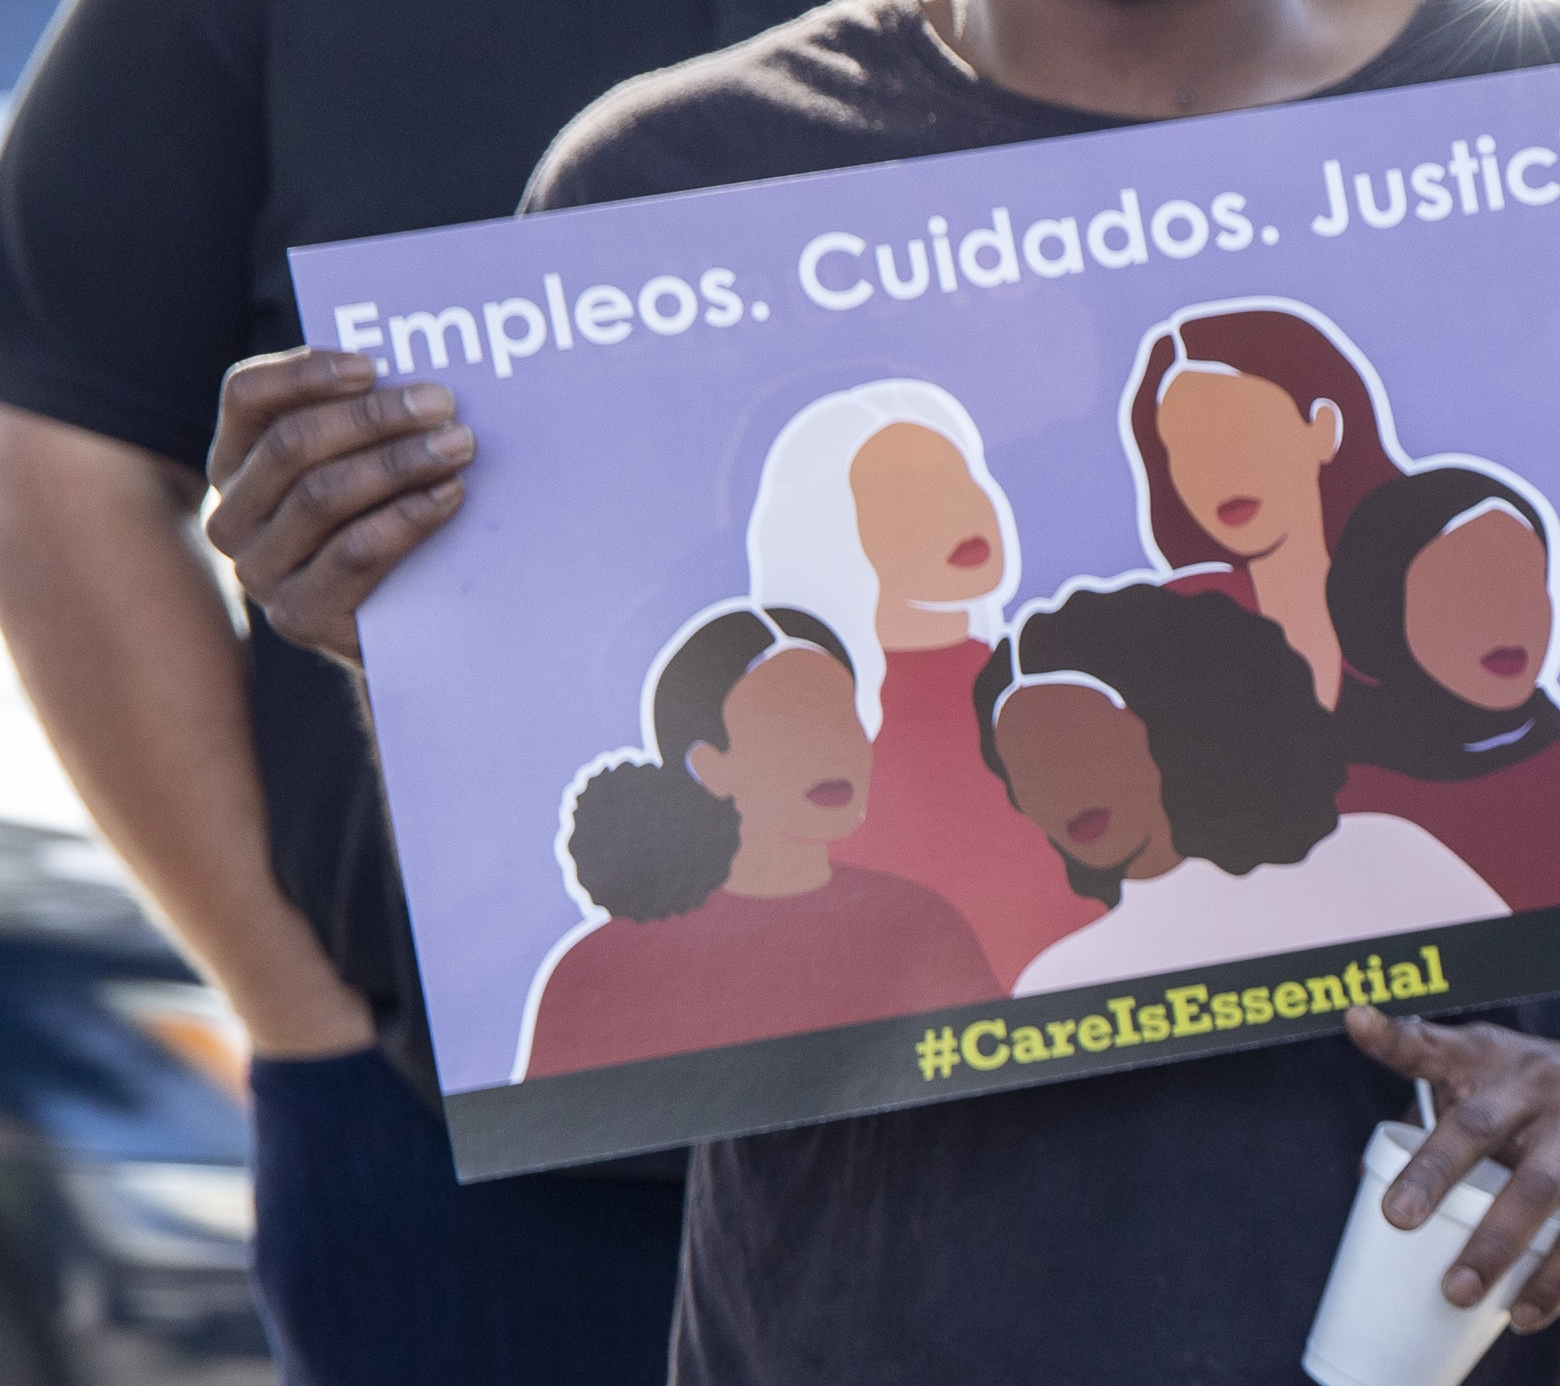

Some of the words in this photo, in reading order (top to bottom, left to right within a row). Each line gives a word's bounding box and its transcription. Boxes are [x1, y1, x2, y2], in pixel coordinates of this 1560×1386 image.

[334, 267, 771, 379] Empleos.
[798, 187, 1281, 311] Cuidados.
[916, 945, 1450, 1081] #CareIsEssential
